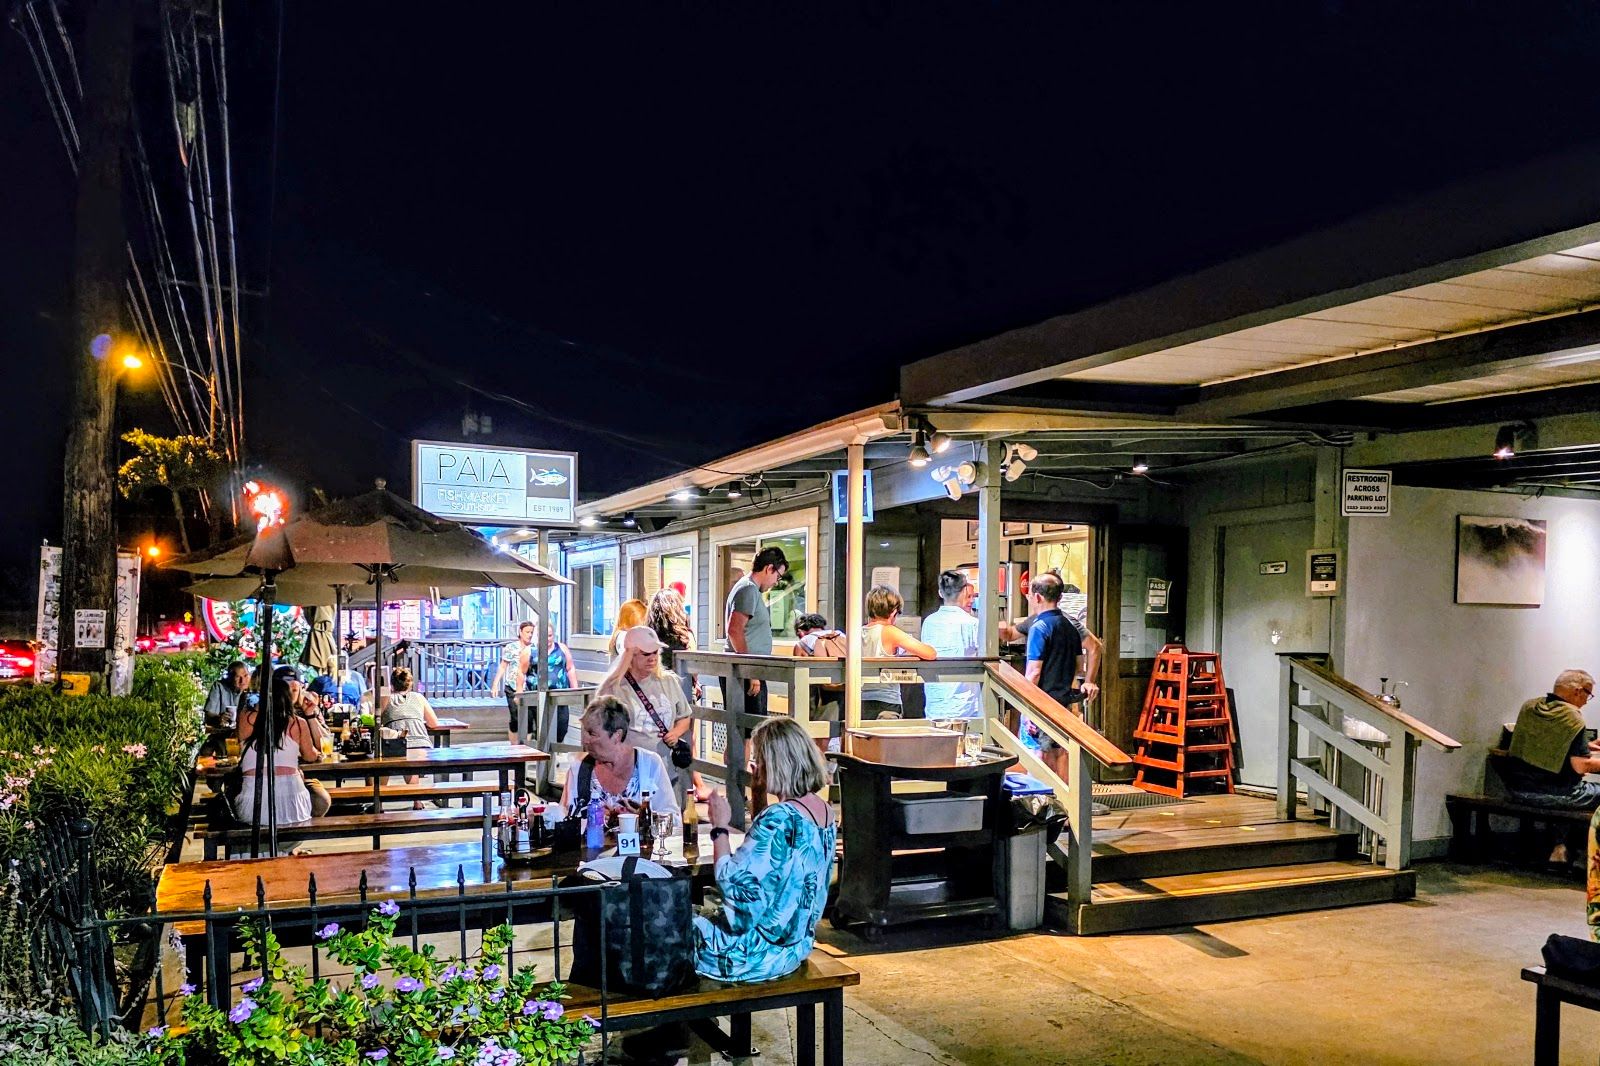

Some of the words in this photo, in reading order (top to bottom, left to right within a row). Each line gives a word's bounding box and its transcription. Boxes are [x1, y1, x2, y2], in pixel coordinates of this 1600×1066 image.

[438, 453, 511, 484] PAIA
[1347, 474, 1387, 482] RESTROOMS
[1347, 494, 1373, 502] PARKING
[533, 504, 546, 512] EST
[548, 505, 564, 513] 1989
[1150, 582, 1165, 590] PASS
[620, 838, 636, 849] 91
